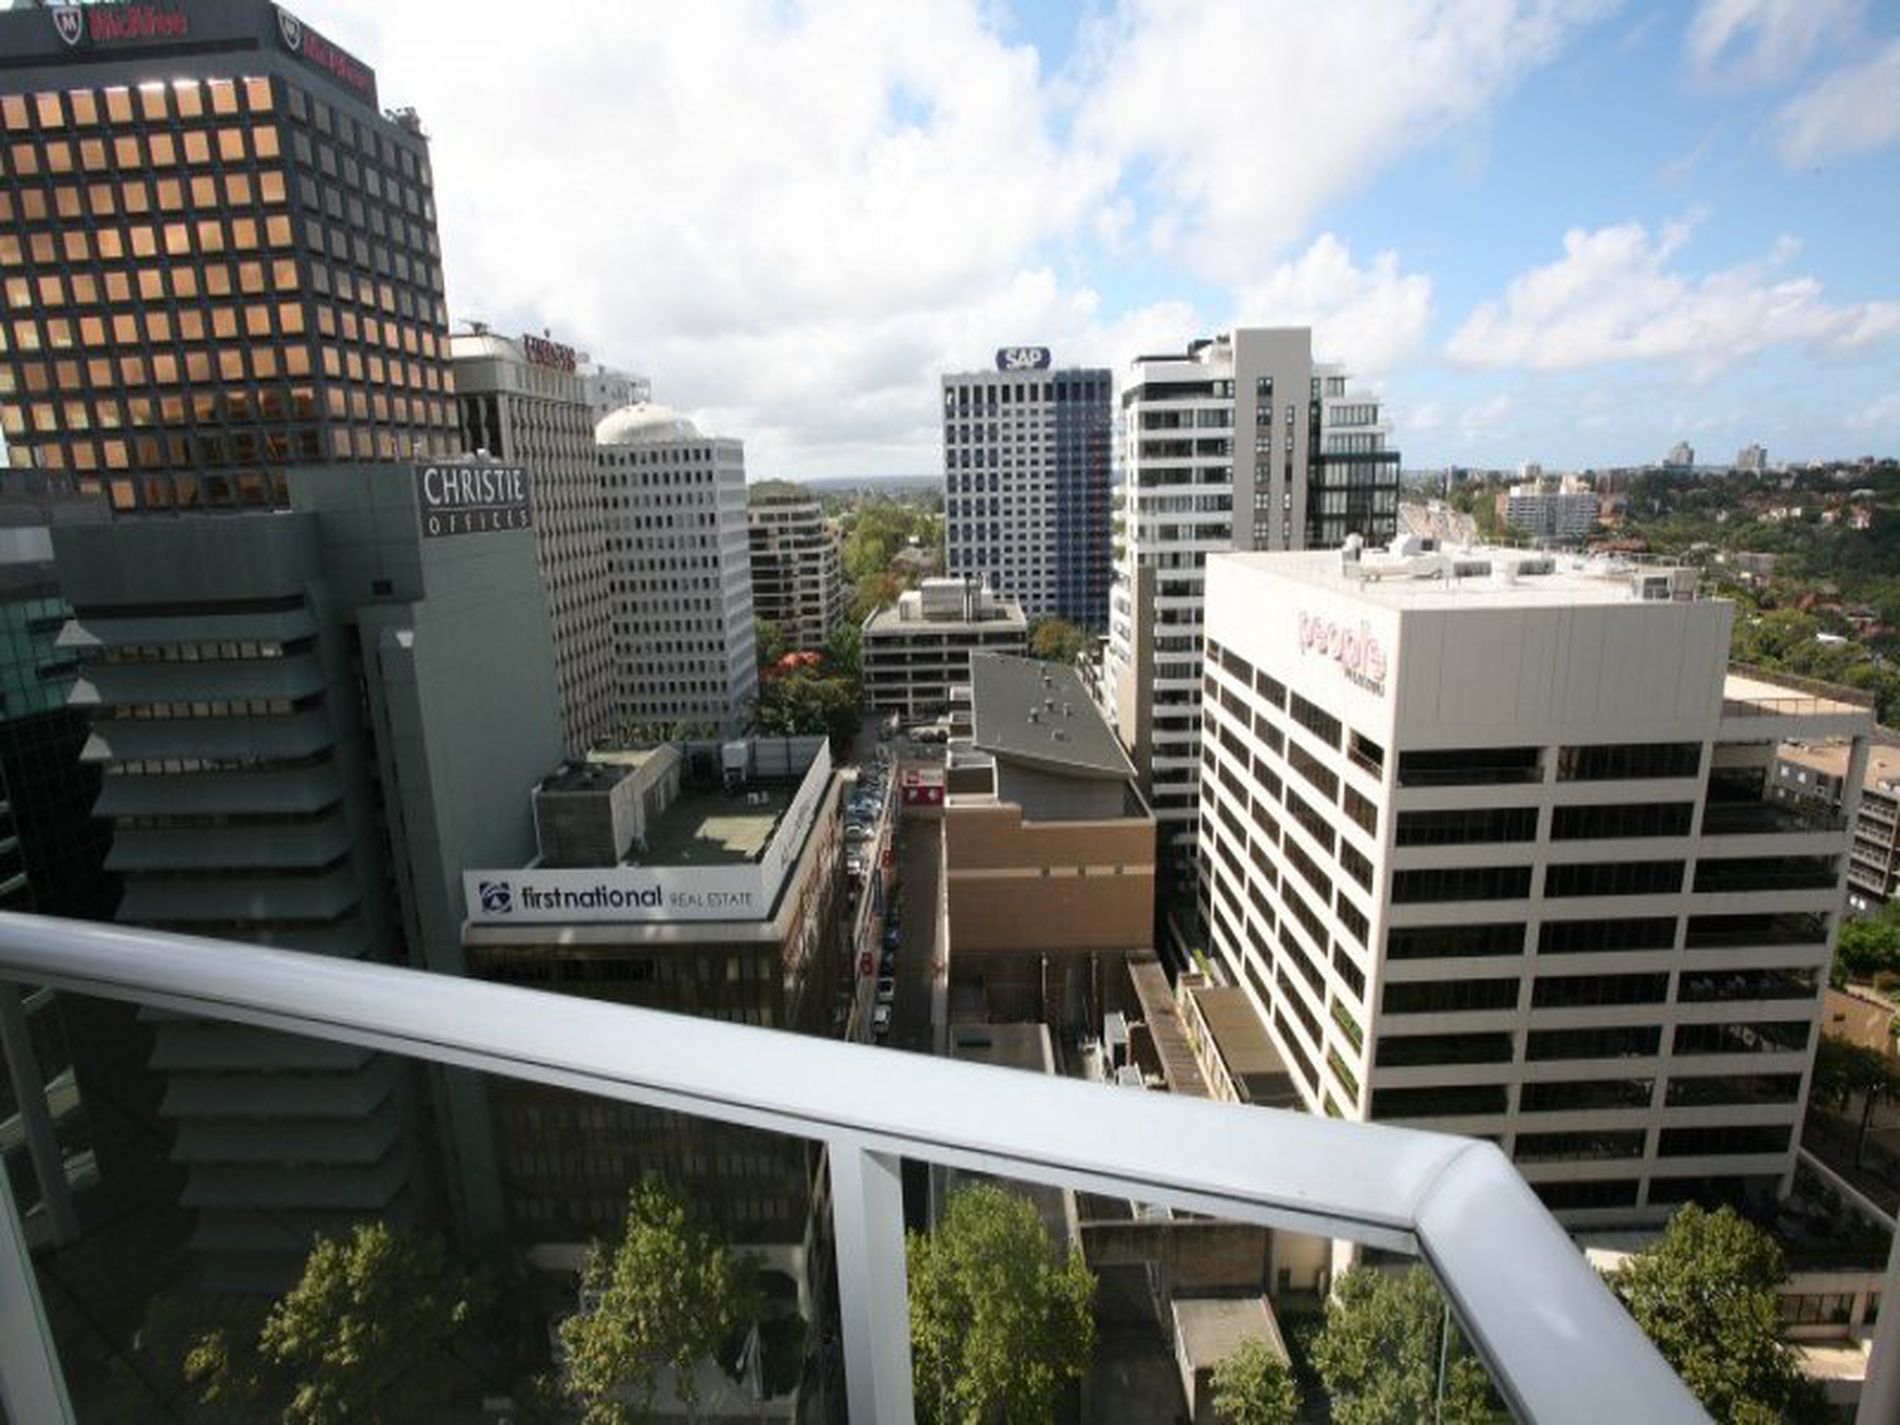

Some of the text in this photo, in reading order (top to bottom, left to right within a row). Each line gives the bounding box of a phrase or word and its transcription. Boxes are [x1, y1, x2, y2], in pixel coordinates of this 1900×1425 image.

[1005, 349, 1042, 369] SAP
[423, 467, 525, 505] CHRISTIE
[428, 509, 530, 536] OFFICES
[669, 892, 704, 908] REAL
[706, 892, 753, 908] ESTATE
